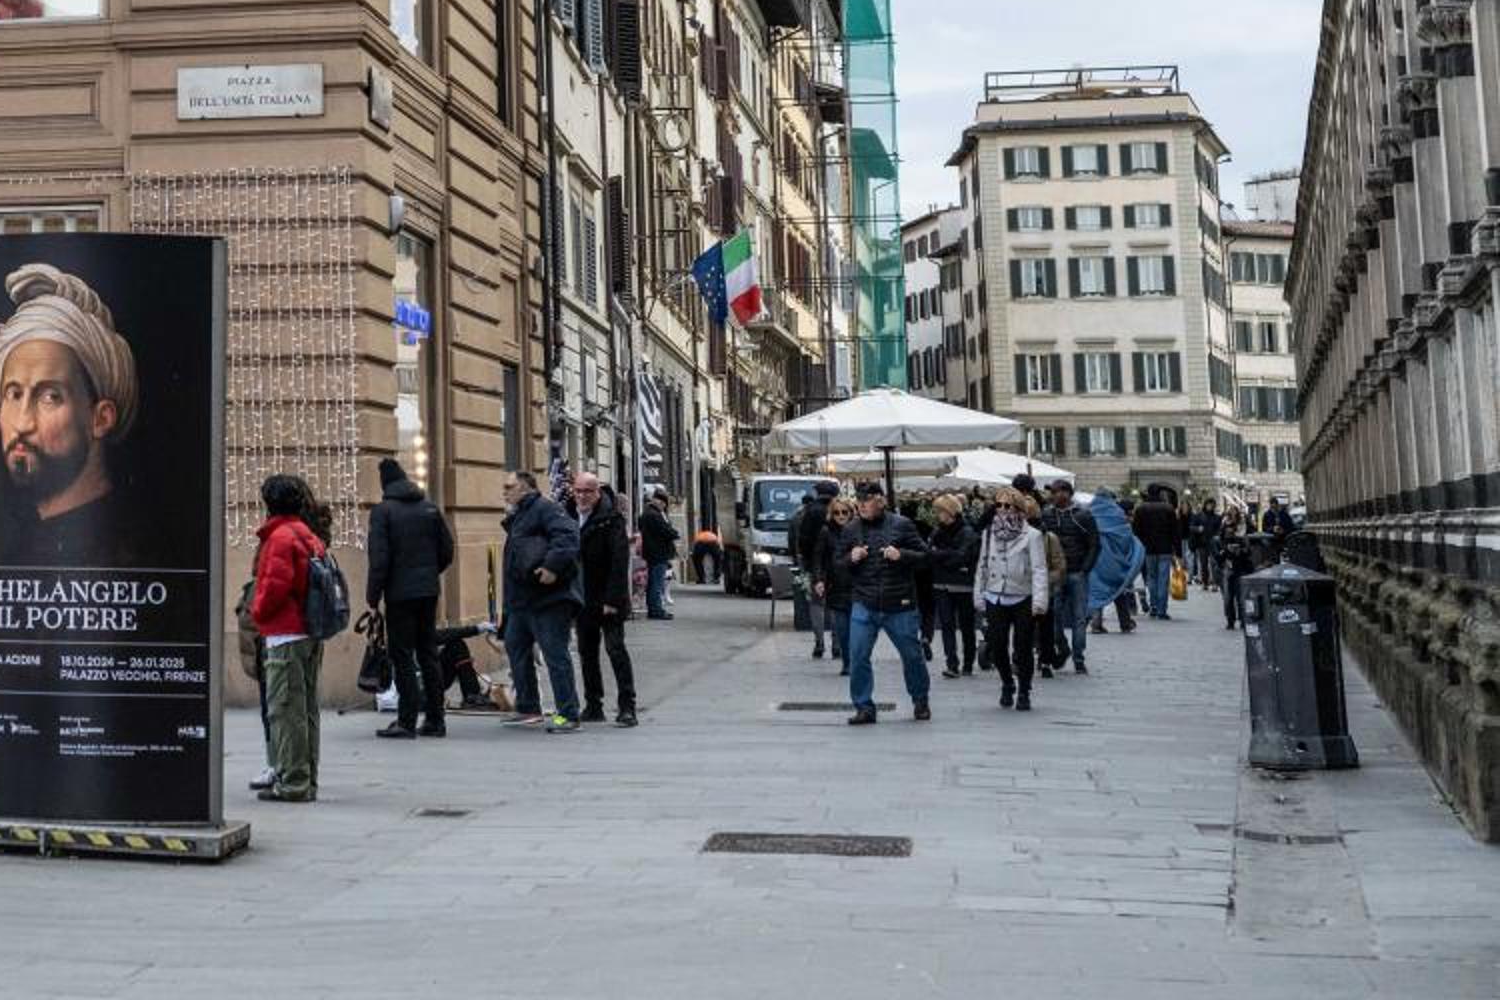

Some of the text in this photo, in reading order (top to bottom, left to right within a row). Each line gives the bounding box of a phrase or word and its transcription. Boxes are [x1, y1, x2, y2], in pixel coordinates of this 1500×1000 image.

[259, 93, 311, 106] ITALIANA
[25, 606, 138, 631] POTERE
[60, 669, 207, 683] PALAZZO VECCHIO, FIRENZE
